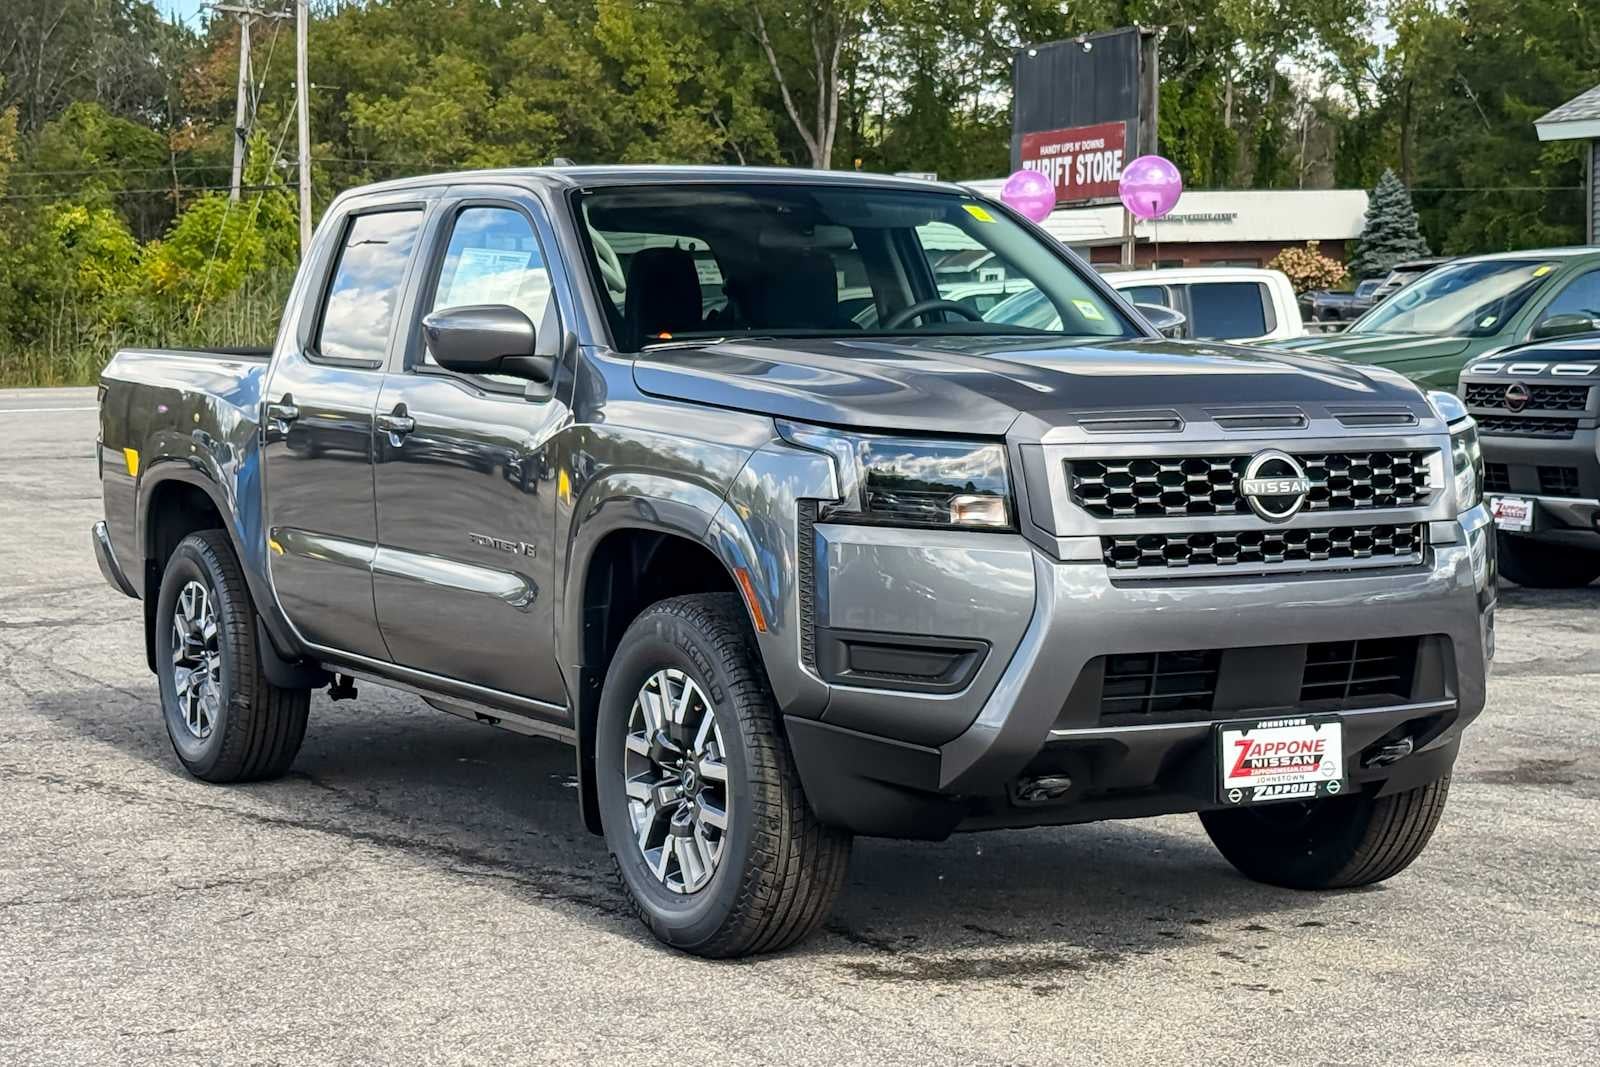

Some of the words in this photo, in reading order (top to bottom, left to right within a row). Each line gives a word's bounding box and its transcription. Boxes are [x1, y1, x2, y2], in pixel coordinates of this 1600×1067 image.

[1040, 144, 1060, 155] HANDY
[1061, 142, 1074, 153] UPS
[1081, 138, 1105, 151] DOWNS
[1076, 150, 1123, 185] STORE
[1245, 481, 1310, 494] NISSAN
[519, 541, 537, 558] V6
[1256, 718, 1307, 729] JOHNSTOWN
[1229, 739, 1326, 778] ZAPPONE
[1251, 755, 1315, 768] NISSAN
[1256, 774, 1305, 784] JOHNSTOWN
[1252, 782, 1317, 801] ZAPPONE
